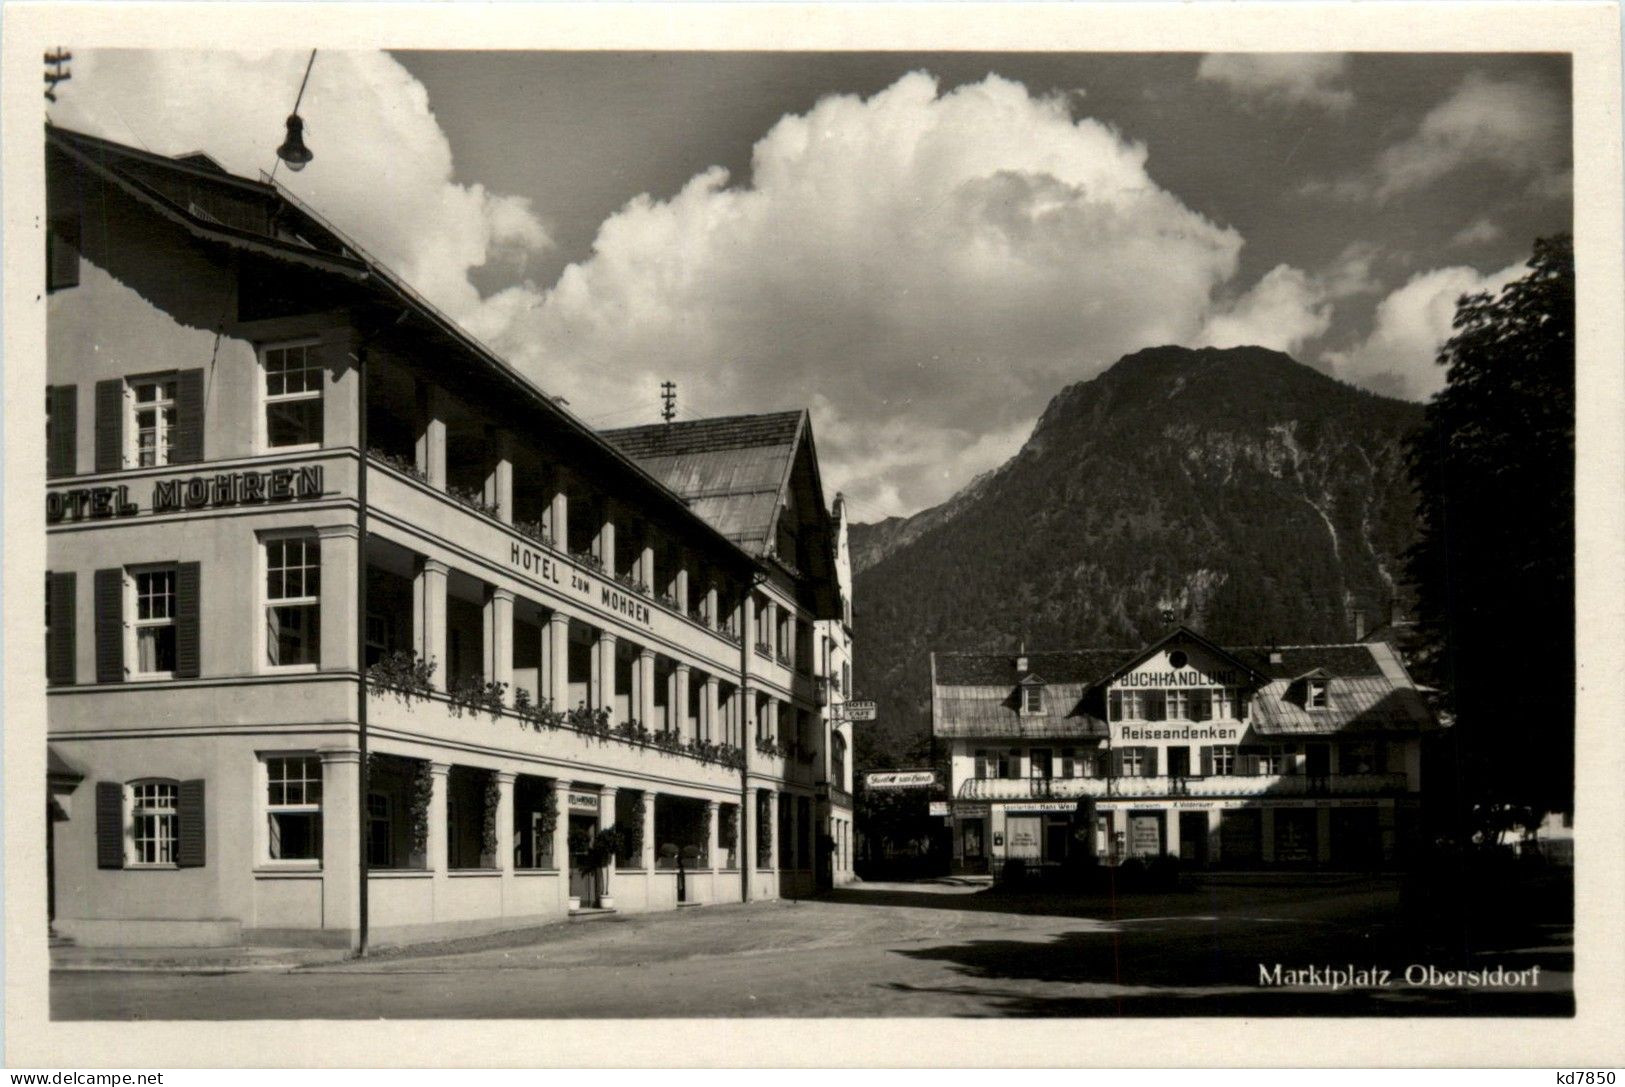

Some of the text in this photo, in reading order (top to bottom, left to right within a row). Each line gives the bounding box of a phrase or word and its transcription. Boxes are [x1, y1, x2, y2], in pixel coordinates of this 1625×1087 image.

[153, 464, 323, 512] MOHREN
[510, 541, 560, 584] HOTEL
[571, 574, 590, 595] ZUM
[1121, 726, 1237, 740] Reiseandenken
